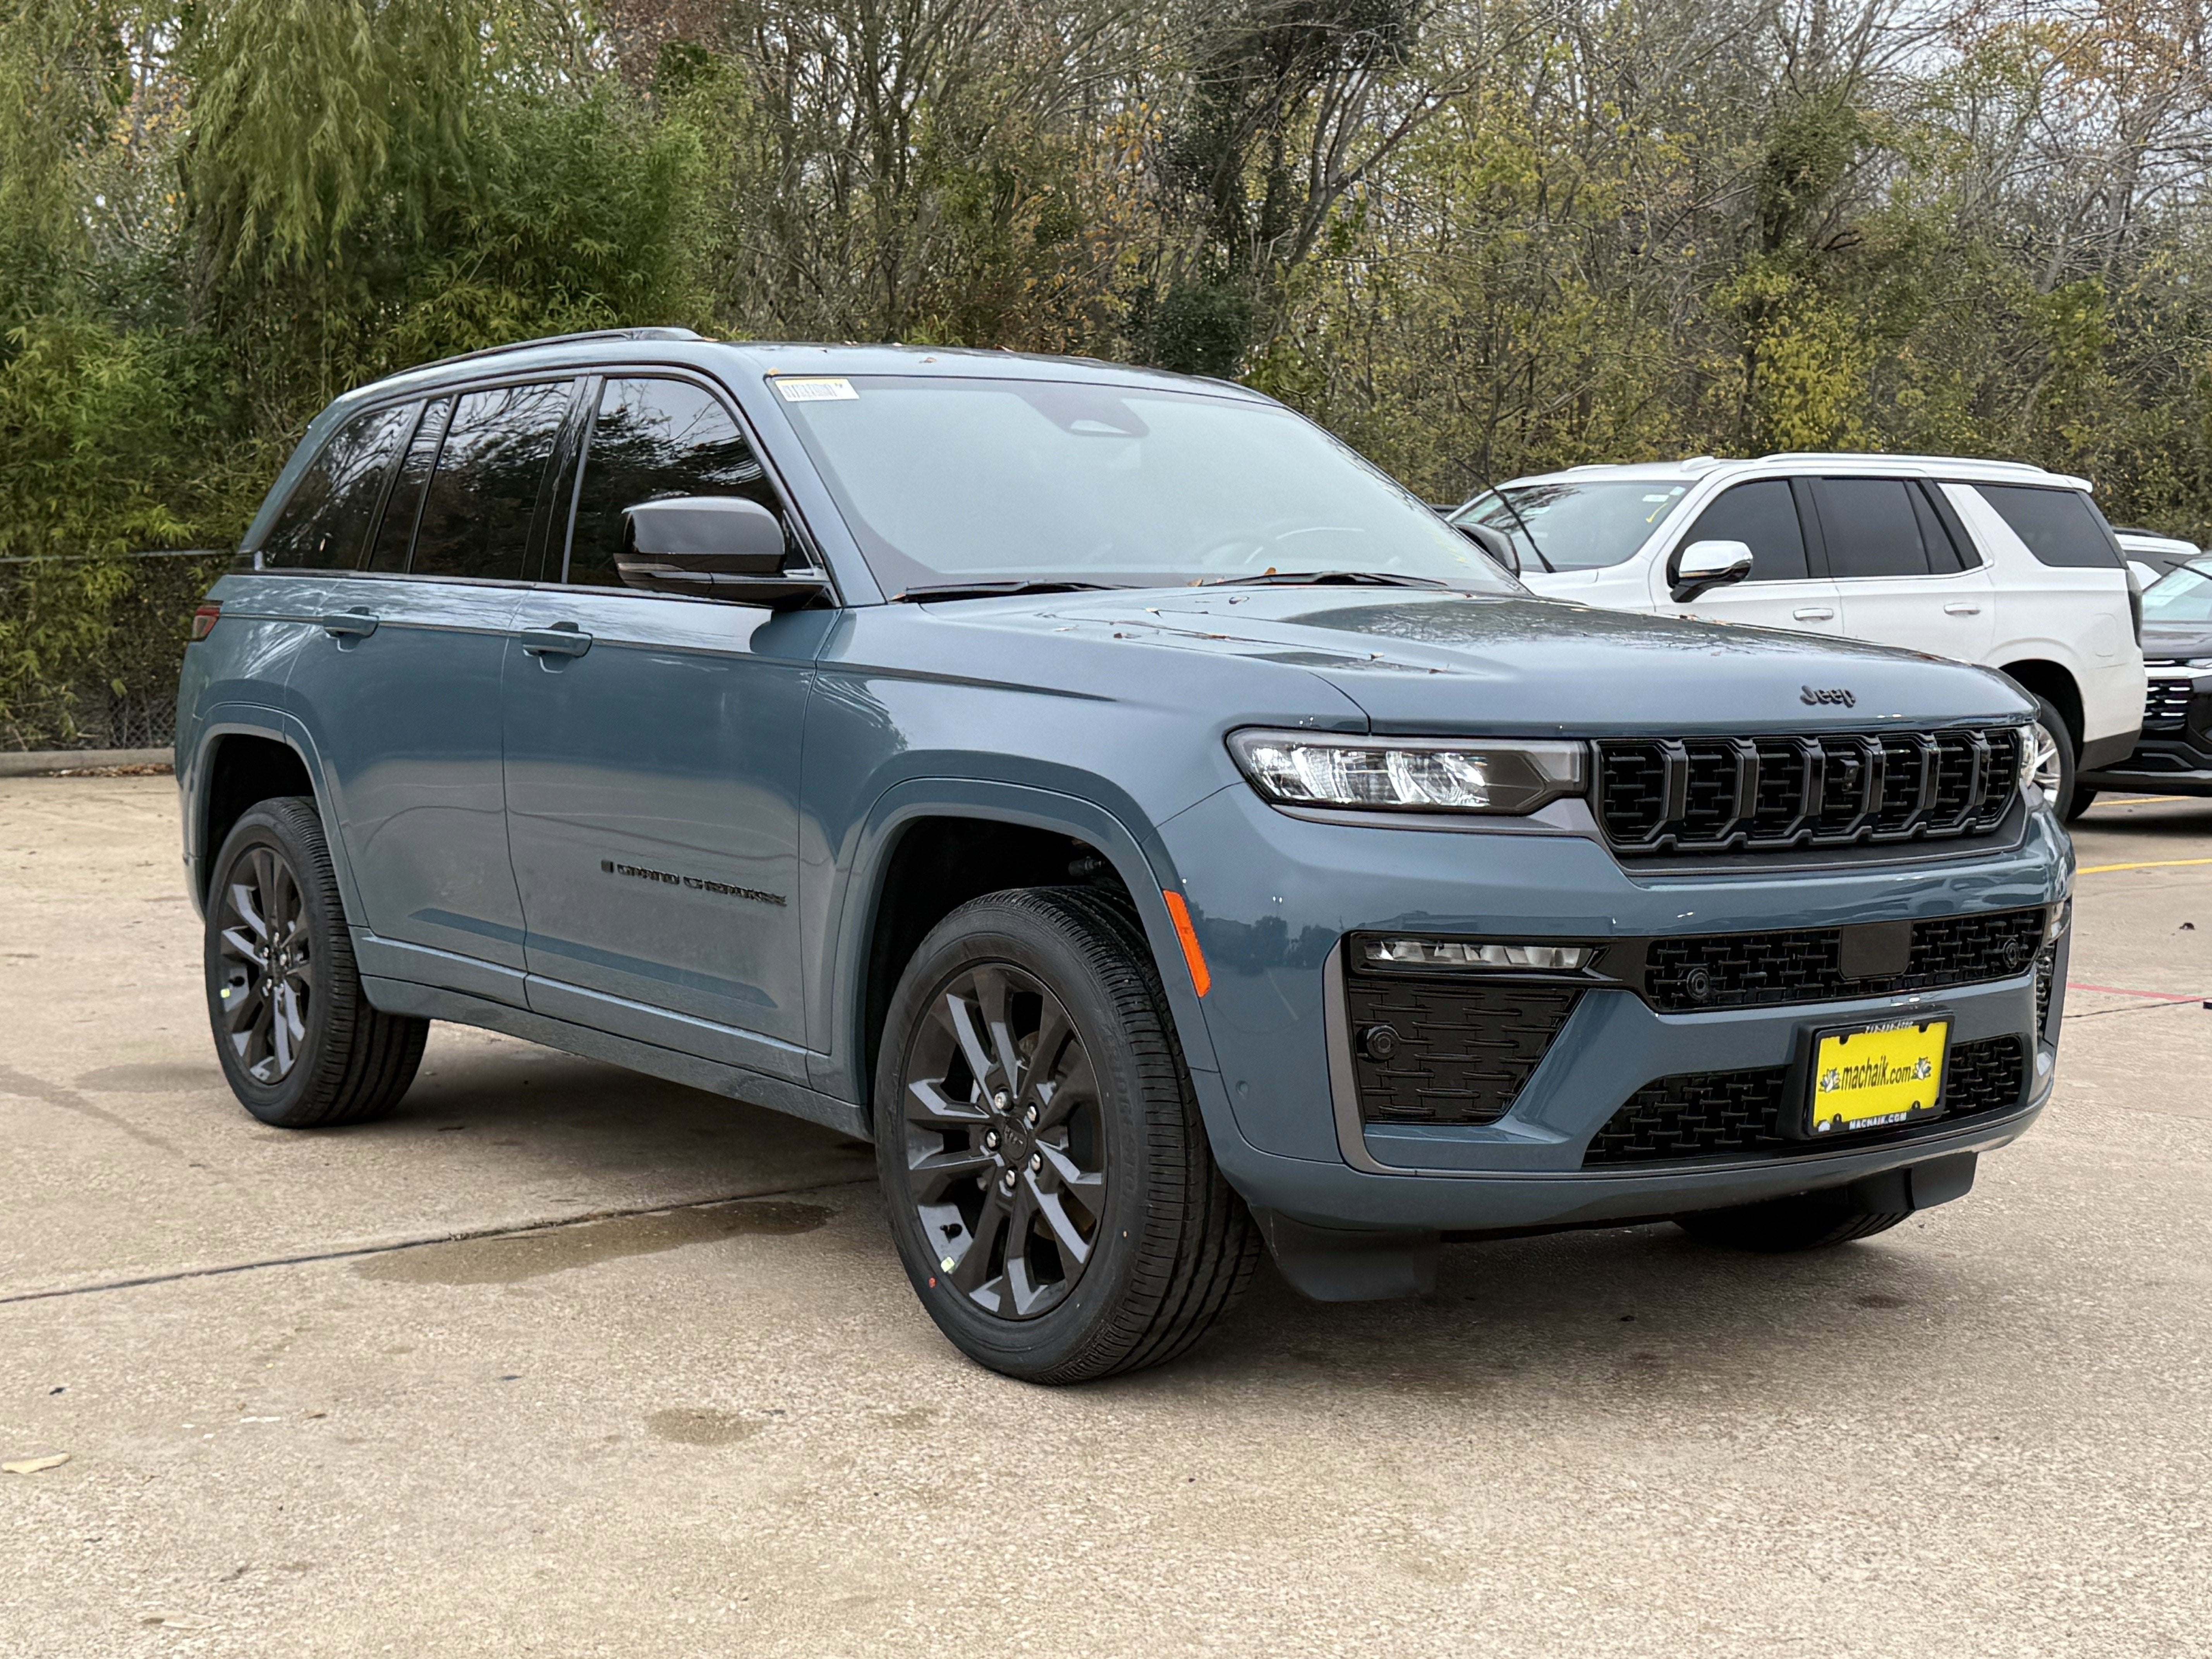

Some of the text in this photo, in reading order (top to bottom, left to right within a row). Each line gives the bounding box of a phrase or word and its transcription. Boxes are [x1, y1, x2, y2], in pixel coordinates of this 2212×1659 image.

[1800, 685, 1856, 708] Jeep
[1841, 1055, 1911, 1091] machaik.com
[1849, 1112, 1907, 1130] MACHAIK.COM
